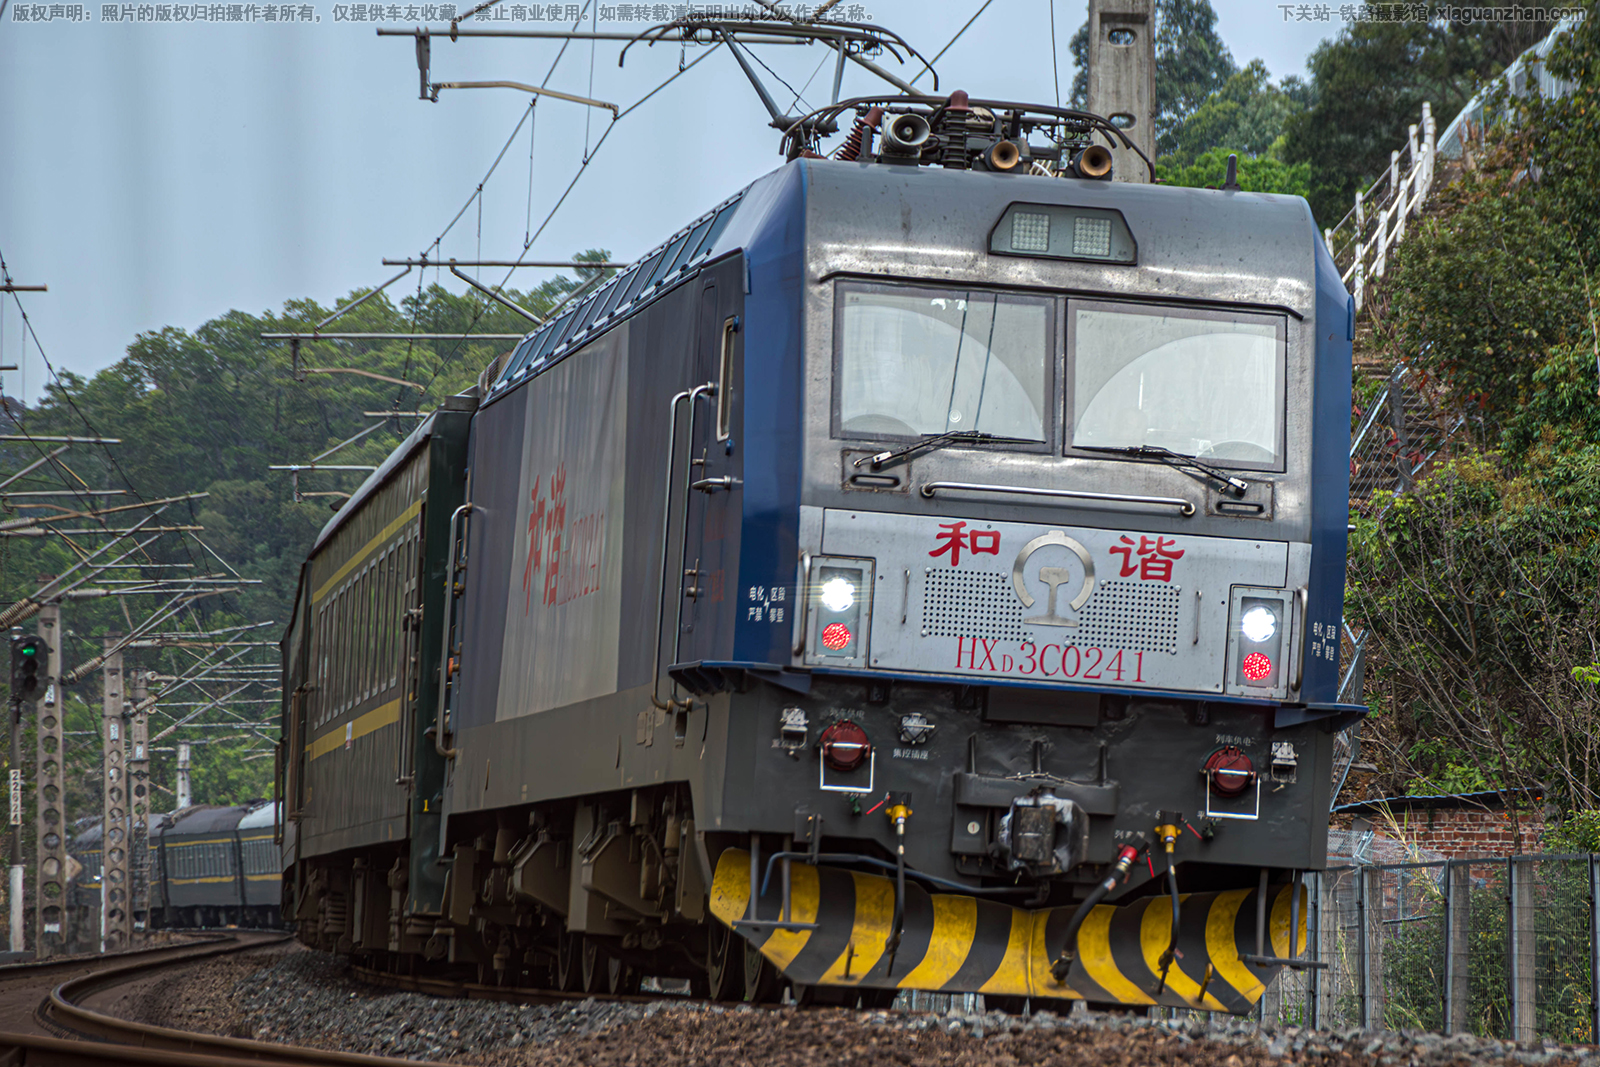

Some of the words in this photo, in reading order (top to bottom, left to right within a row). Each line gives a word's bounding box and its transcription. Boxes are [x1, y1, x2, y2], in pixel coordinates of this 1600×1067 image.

[928, 521, 1001, 567] 和
[1109, 535, 1185, 583] 谐
[955, 636, 1146, 683] HXD3C0241
[423, 799, 429, 812] 1
